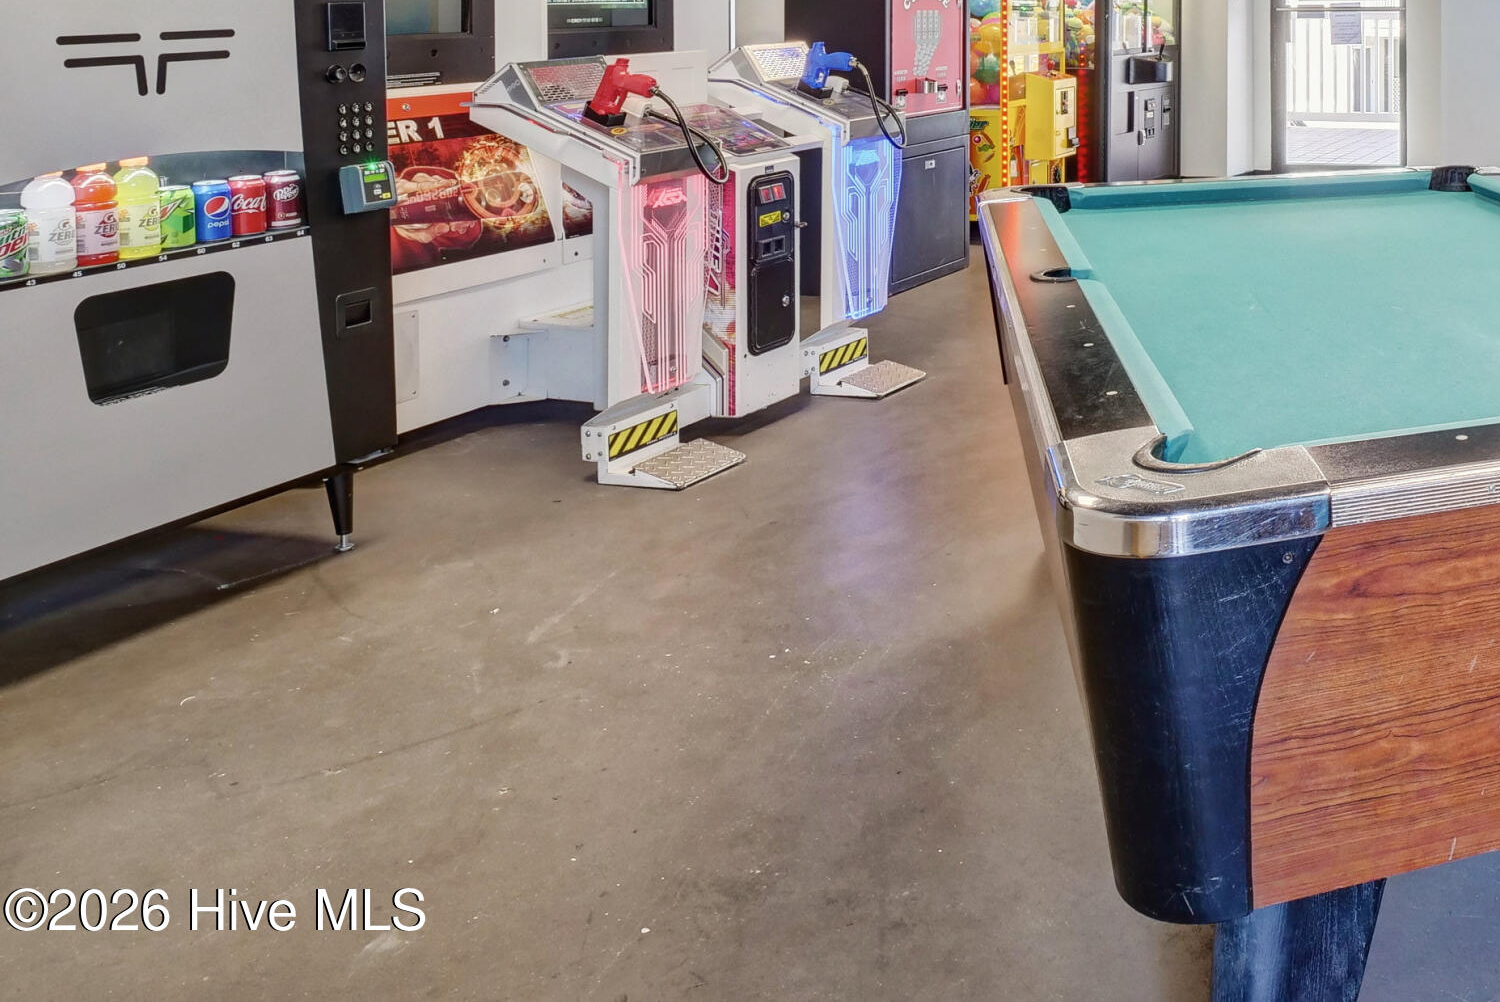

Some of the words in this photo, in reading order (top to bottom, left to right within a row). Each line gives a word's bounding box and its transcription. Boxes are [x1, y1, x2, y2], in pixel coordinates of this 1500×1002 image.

[428, 117, 444, 139] 1
[139, 216, 158, 228] ZER
[208, 219, 230, 228] pepsi
